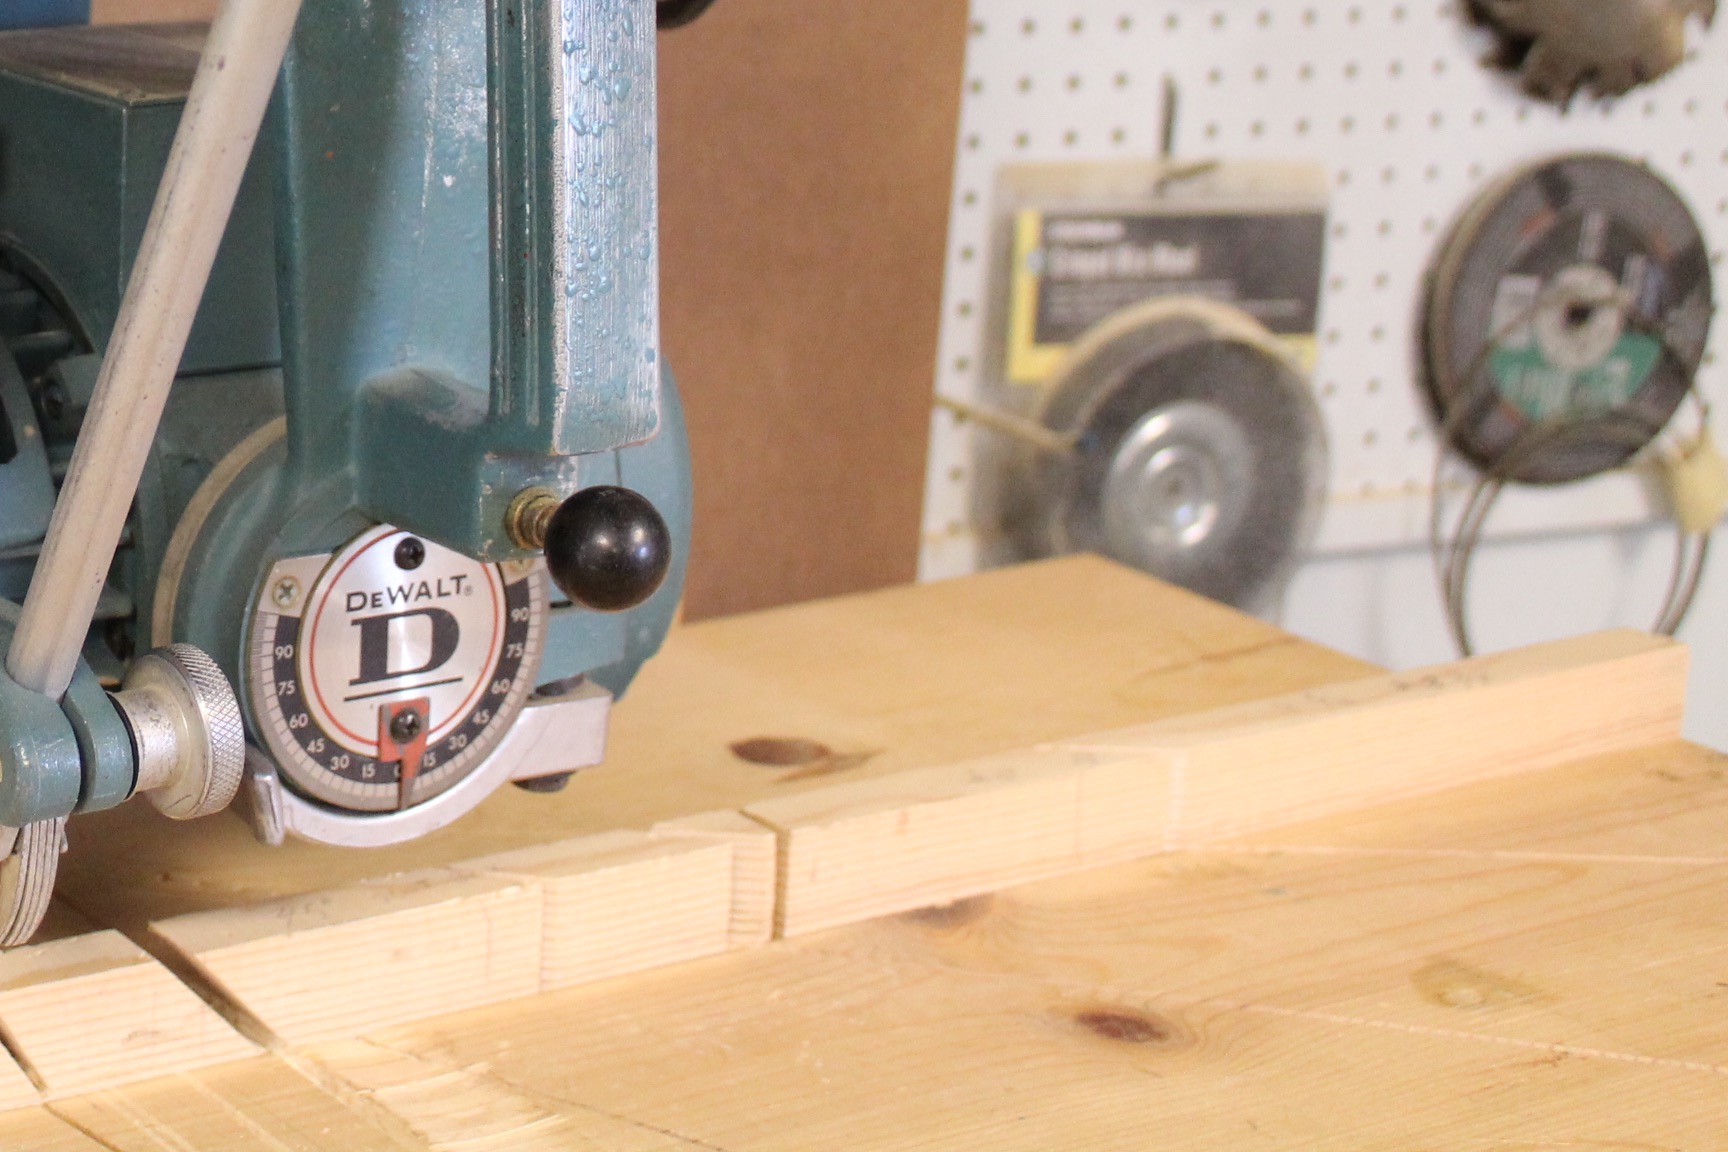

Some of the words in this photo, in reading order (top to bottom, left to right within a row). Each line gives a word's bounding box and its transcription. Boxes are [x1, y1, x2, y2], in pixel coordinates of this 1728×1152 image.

[511, 607, 529, 622] 90
[274, 644, 293, 660] 90
[349, 606, 460, 686] D
[505, 643, 522, 659] 75
[278, 680, 296, 696] 75
[491, 678, 511, 695] 60
[289, 713, 309, 728] 60
[472, 709, 490, 725] 45
[306, 738, 325, 753] 45
[448, 734, 468, 750] 30
[330, 755, 350, 770] 30
[423, 752, 437, 767] 15
[362, 763, 376, 778] 15
